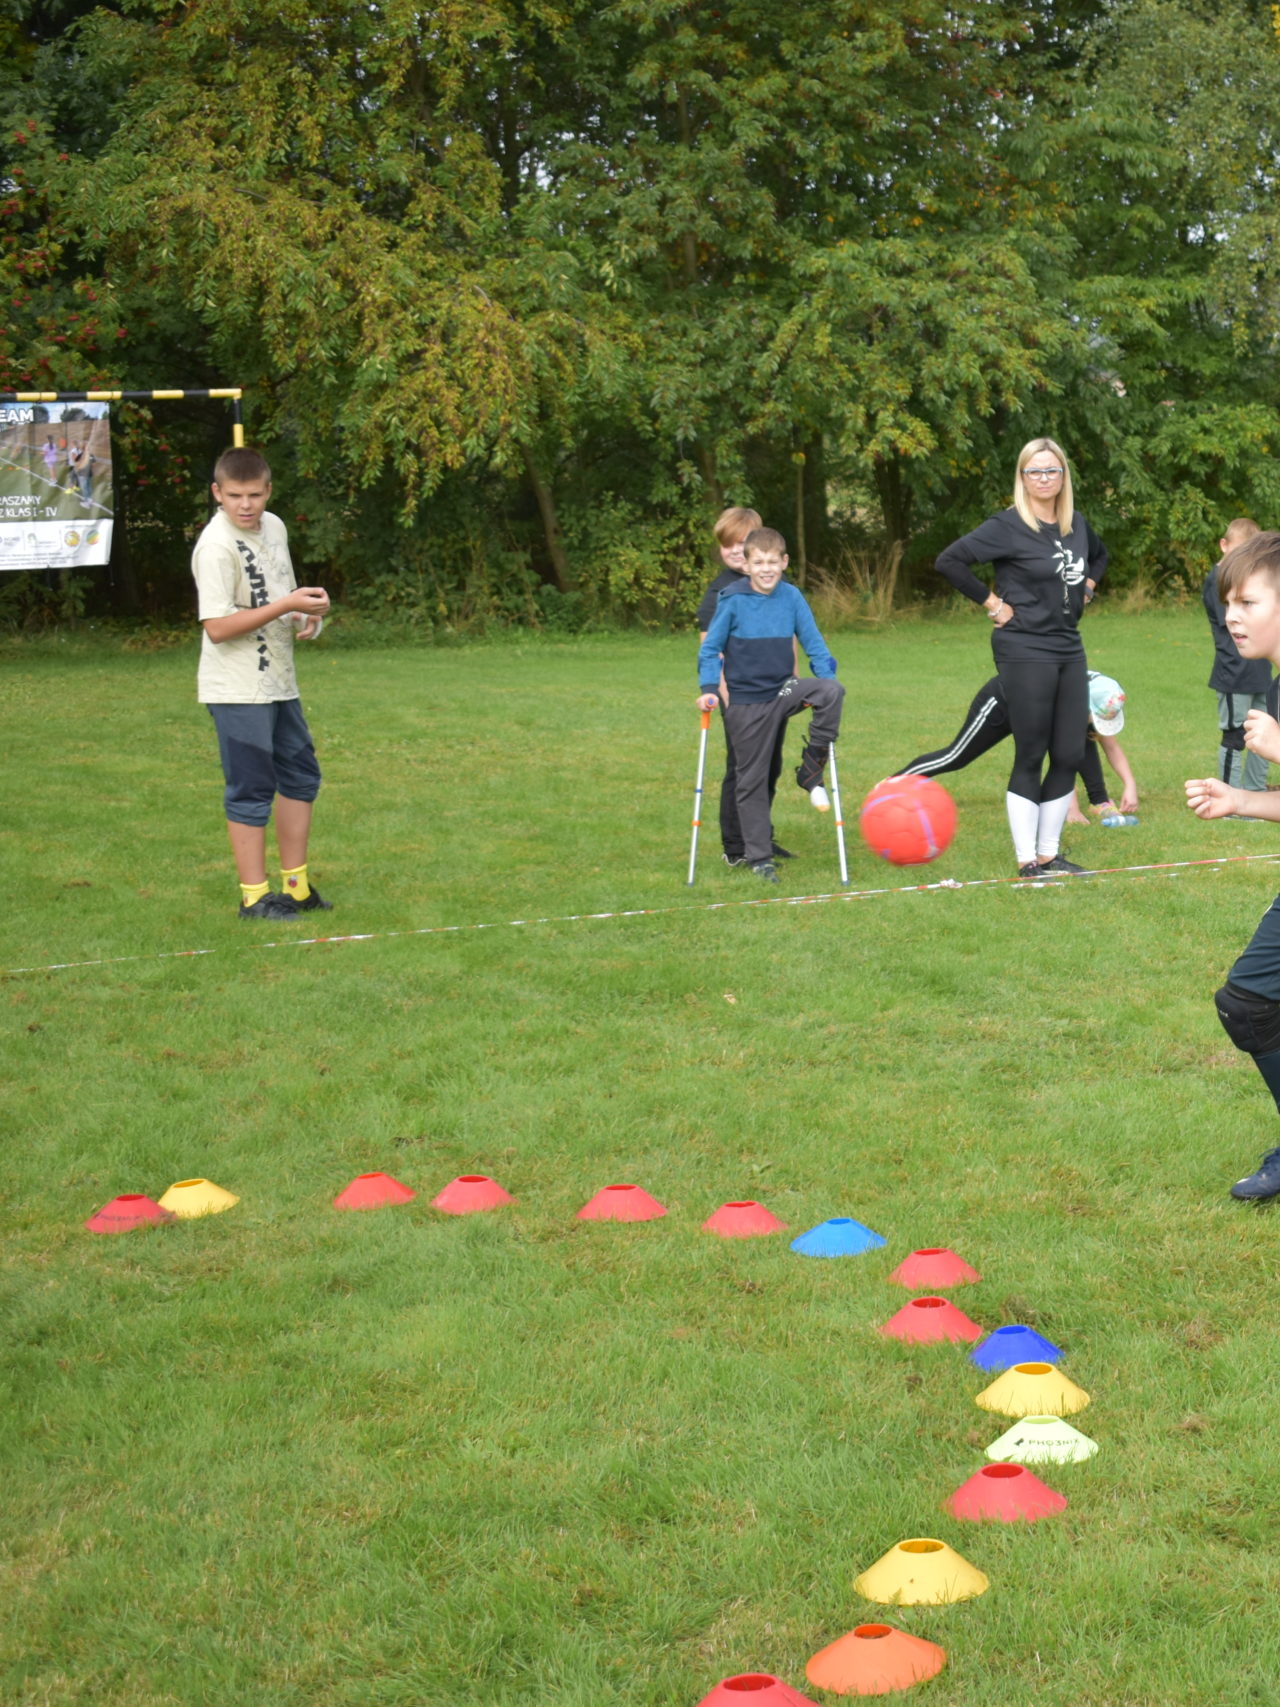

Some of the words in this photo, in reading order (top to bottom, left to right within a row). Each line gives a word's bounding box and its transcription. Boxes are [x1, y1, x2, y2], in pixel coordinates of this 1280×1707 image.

[0, 495, 41, 505] ASZAMY
[6, 507, 31, 518] KLAS
[45, 506, 57, 517] IV
